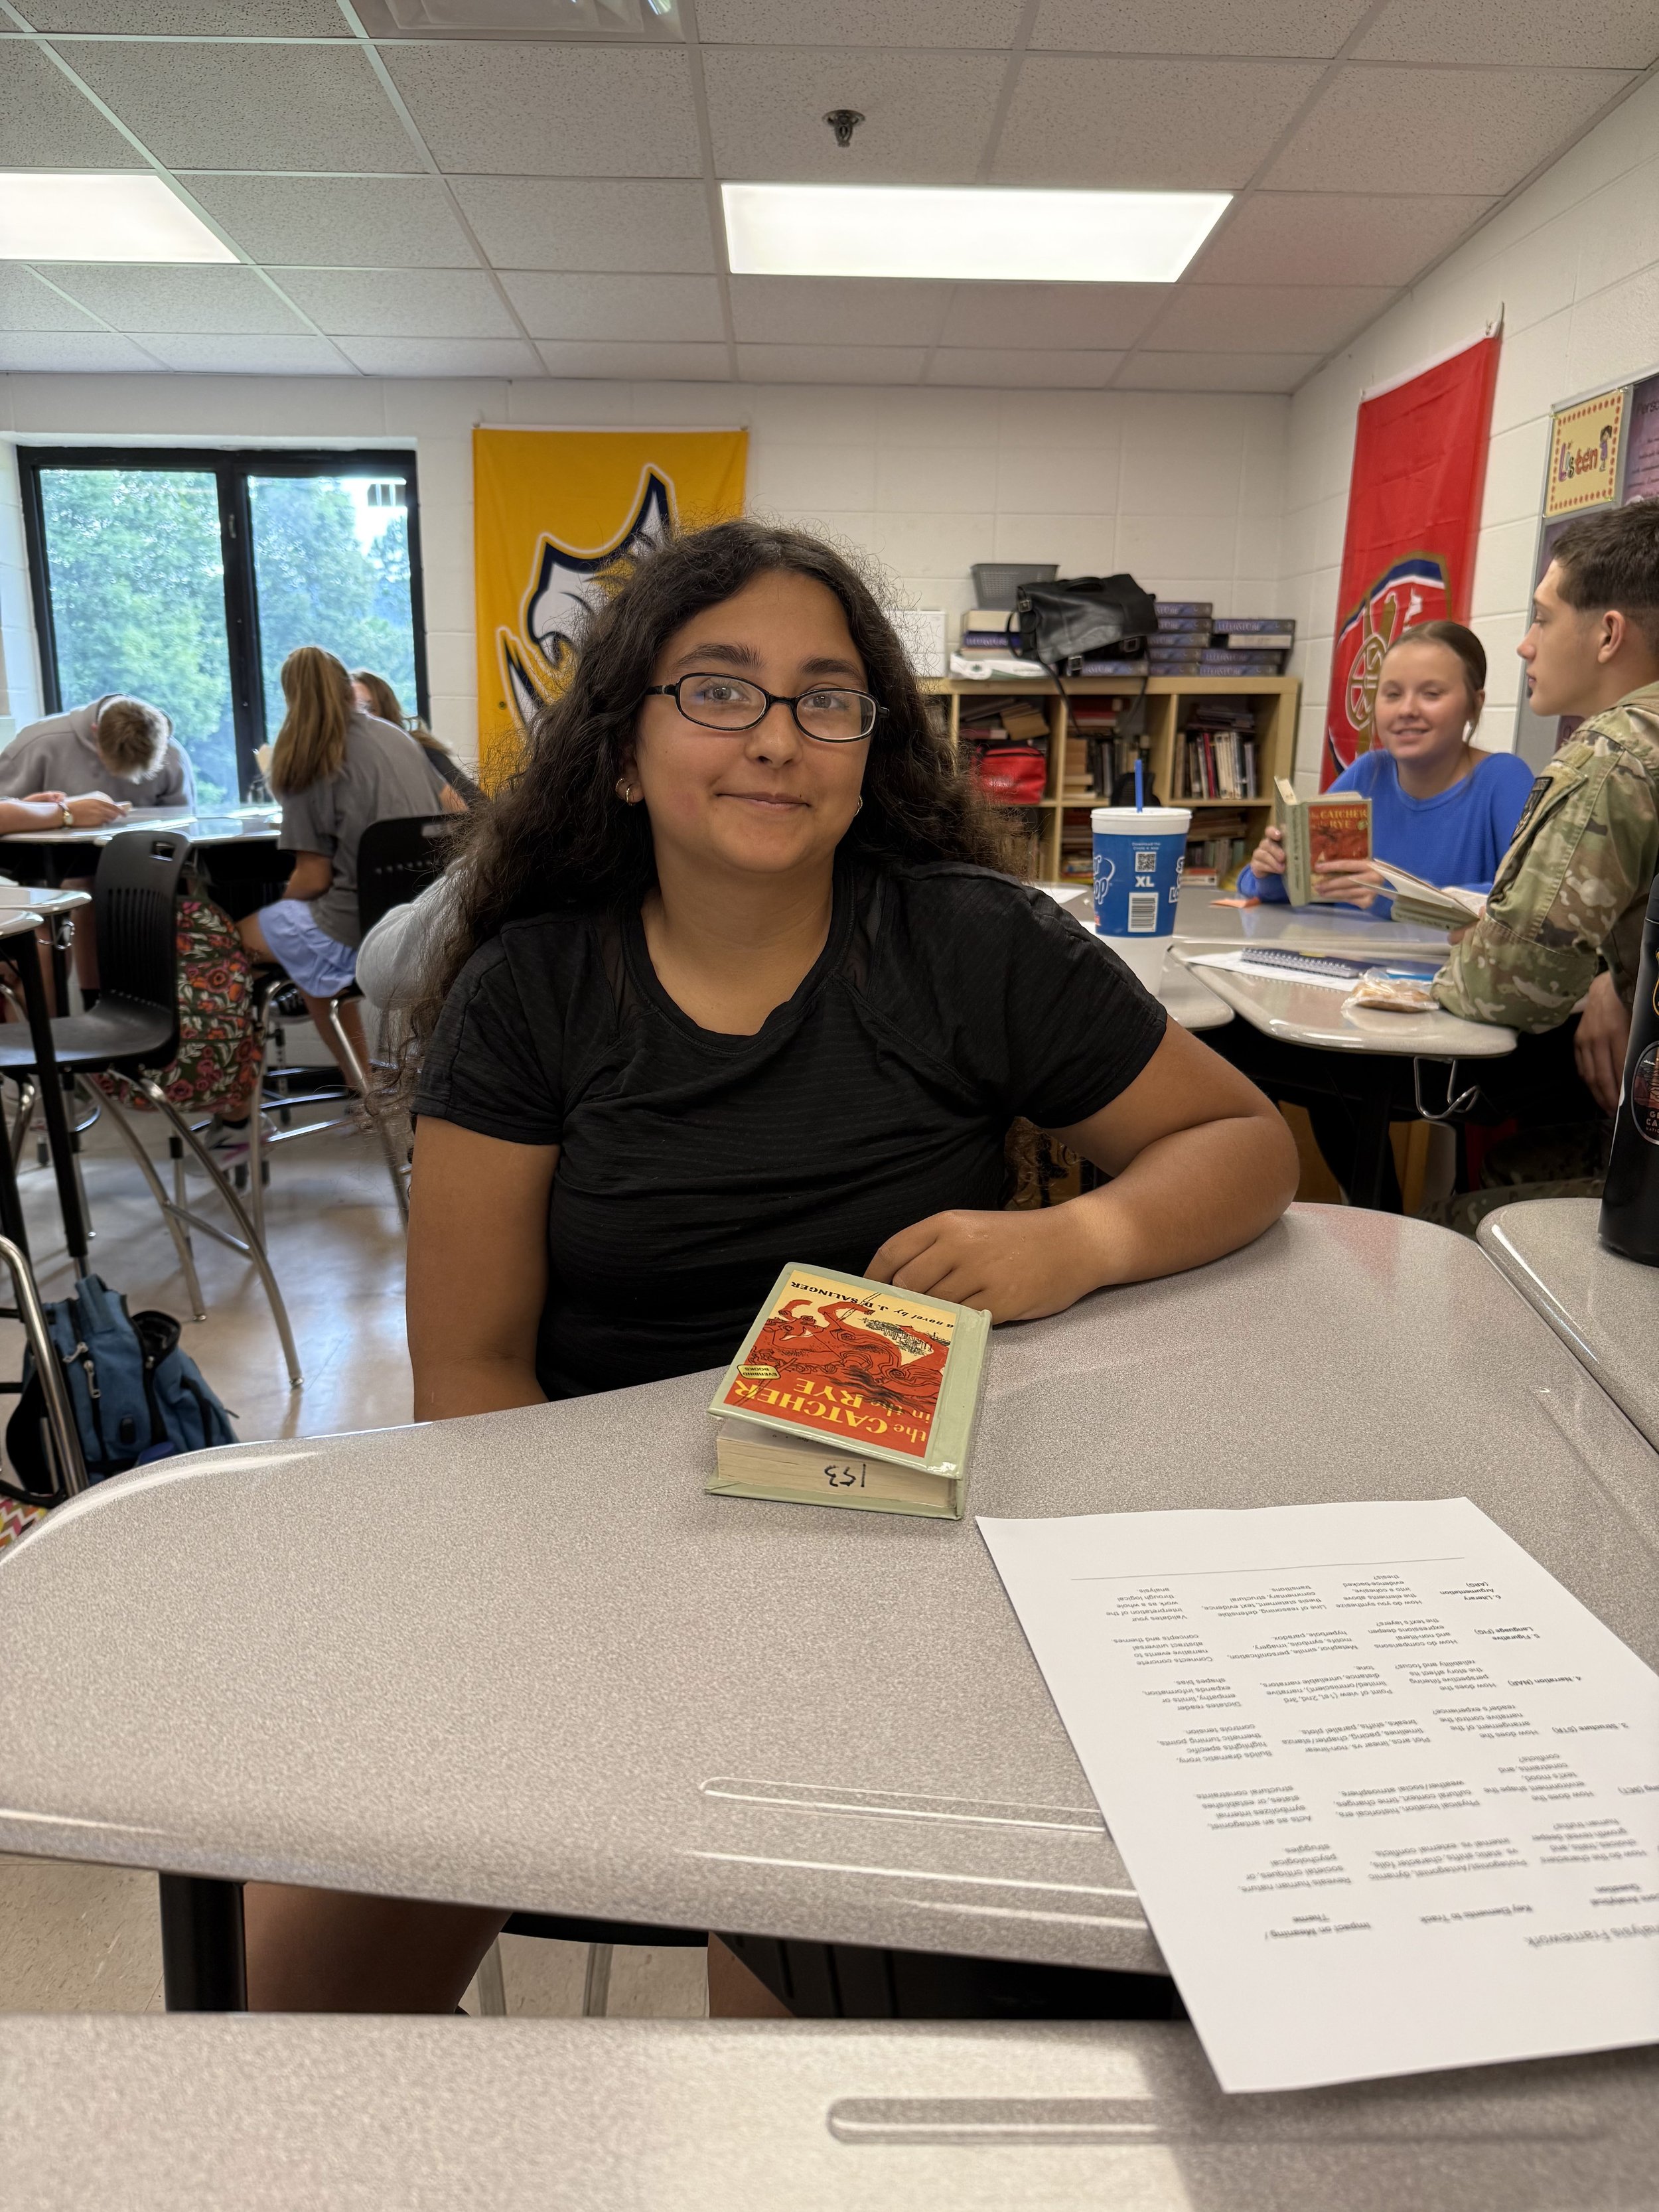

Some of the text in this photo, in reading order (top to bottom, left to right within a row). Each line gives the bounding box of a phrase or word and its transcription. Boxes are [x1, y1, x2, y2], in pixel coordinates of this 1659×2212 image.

[1558, 441, 1598, 482] Listen
[1320, 809, 1367, 819] CATCHER
[1330, 820, 1352, 829] RYE
[1135, 875, 1155, 887] XL
[791, 1282, 858, 1303] SALINGER
[910, 1315, 944, 1325] novel
[793, 1378, 930, 1423] in the RYE
[735, 1380, 926, 1442] the CATCHER
[824, 1464, 866, 1487] 153
[1227, 1650, 1290, 1659] personification,
[1302, 1676, 1342, 1684] unreliable
[1303, 1681, 1387, 1693] limited/omniscient),
[1463, 1907, 1512, 1919] Elements
[1512, 1904, 1533, 1913] Key
[1292, 1914, 1330, 1923] Theme
[1420, 1915, 1451, 1924] Track
[1334, 1922, 1372, 1933] Impact
[1269, 1928, 1317, 1939] Meaning
[1524, 1930, 1611, 1949] Framework
